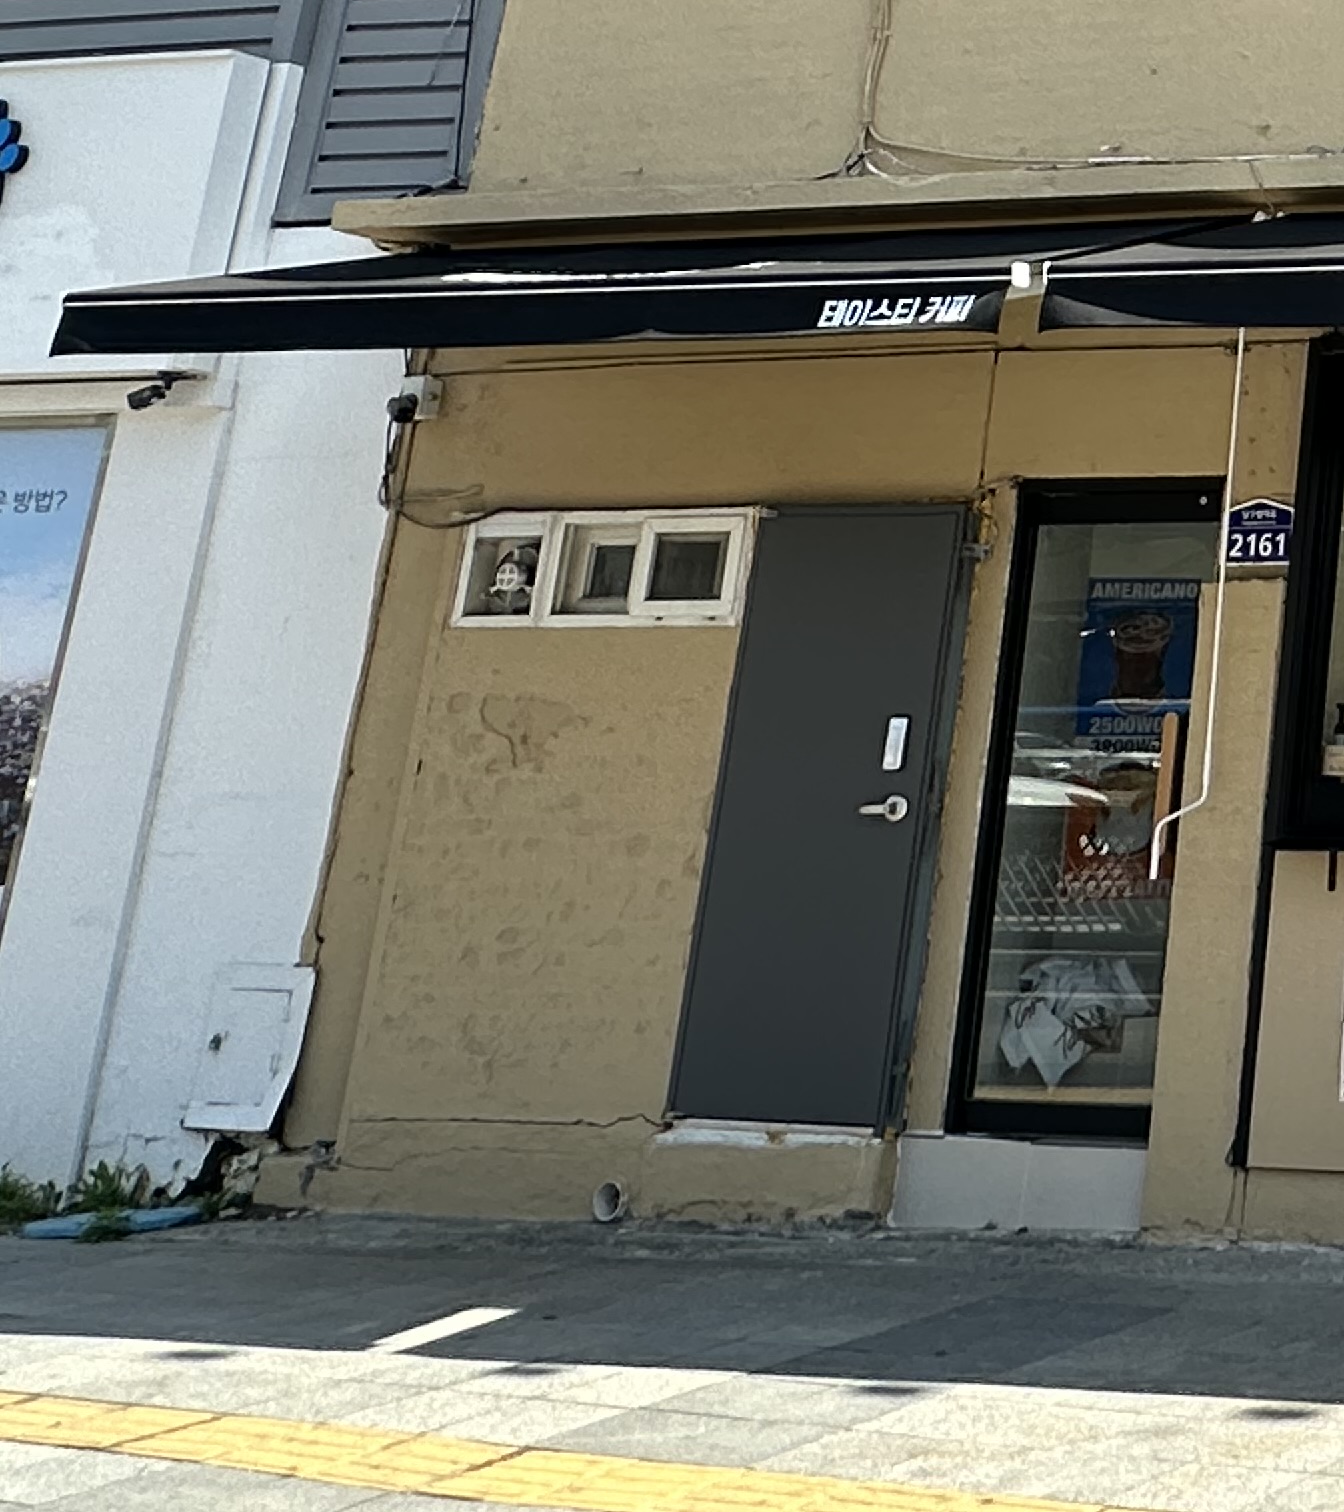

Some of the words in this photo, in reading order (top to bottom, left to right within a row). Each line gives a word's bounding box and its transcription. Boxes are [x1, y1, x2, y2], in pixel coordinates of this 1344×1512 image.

[817, 297, 921, 327] 테이스티
[918, 294, 977, 324] 커피
[13, 488, 68, 514] 방법?
[1229, 532, 1286, 557] 2161
[1091, 582, 1198, 599] AMERICANO
[1089, 716, 1163, 734] 2500WO
